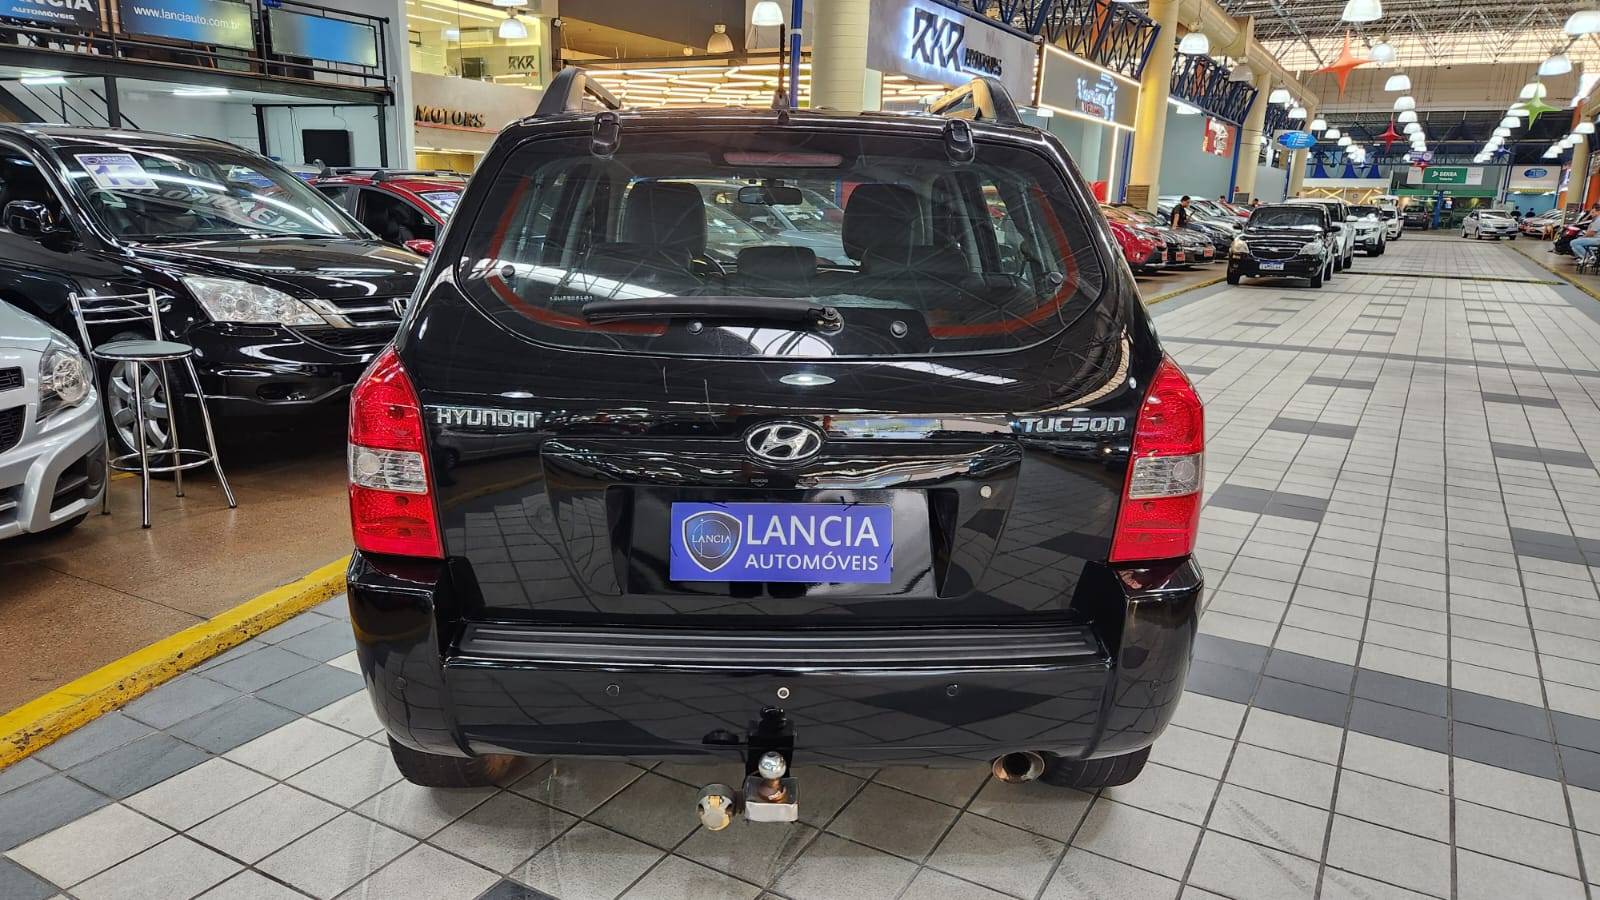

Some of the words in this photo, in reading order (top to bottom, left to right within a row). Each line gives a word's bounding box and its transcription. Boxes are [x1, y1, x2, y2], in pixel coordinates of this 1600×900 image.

[133, 6, 241, 30] www.lanciauto.com.br
[911, 7, 965, 72] RKR
[415, 104, 485, 129] MOTORS
[437, 408, 535, 428] HYUNDAI
[1020, 416, 1126, 433] TUCSON
[691, 534, 732, 544] LANCIA
[746, 514, 880, 547] LANCIA
[744, 551, 879, 571] AUTOMÓVEIS
